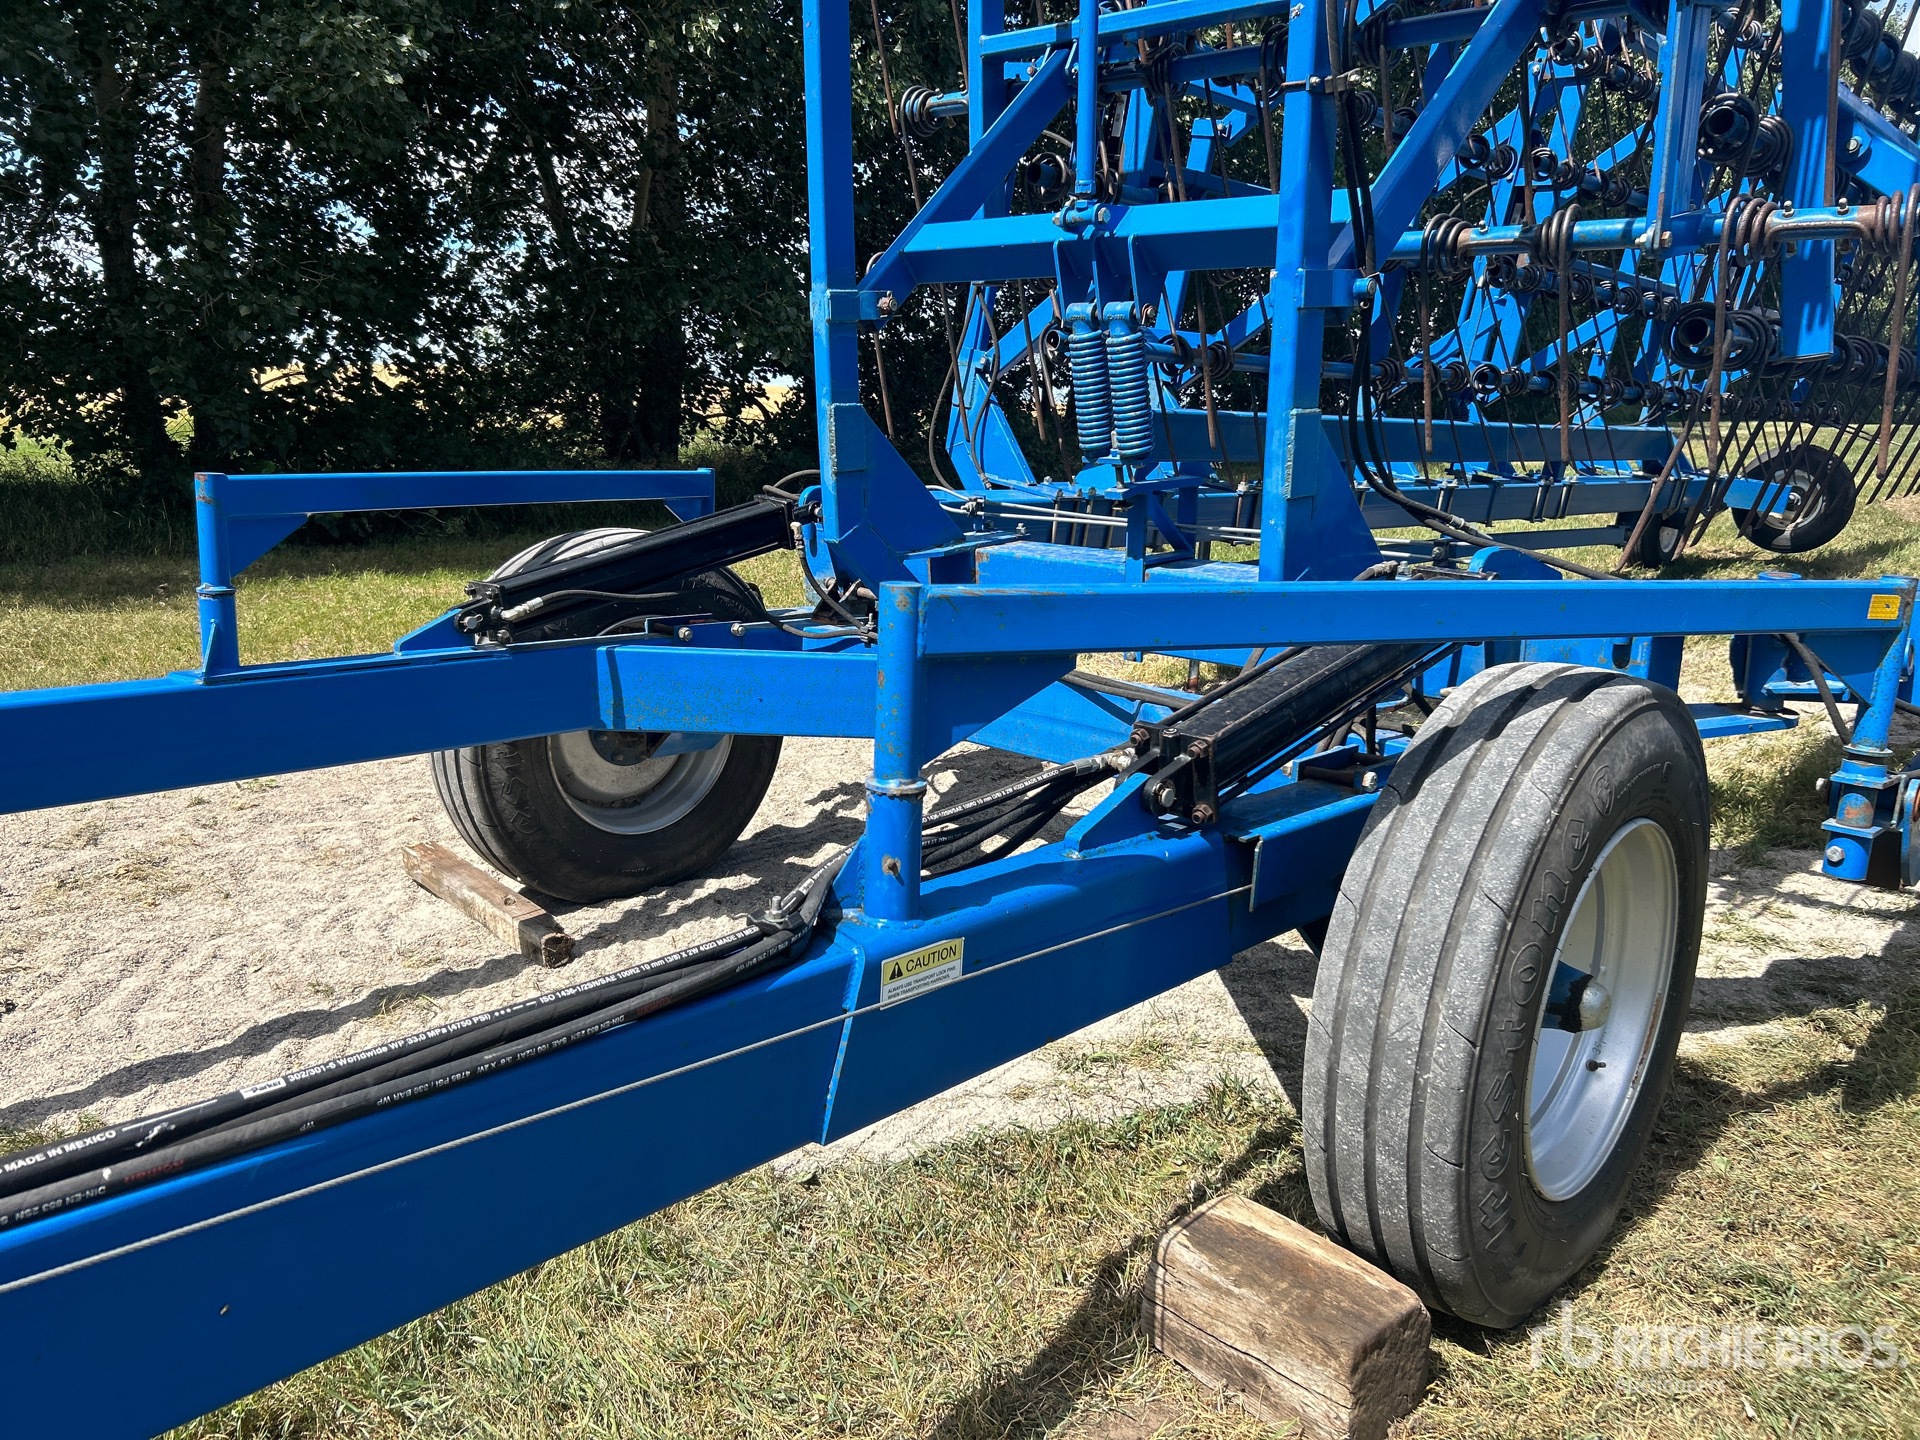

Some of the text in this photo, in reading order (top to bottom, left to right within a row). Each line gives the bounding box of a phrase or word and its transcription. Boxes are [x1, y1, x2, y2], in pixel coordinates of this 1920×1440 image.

[1024, 778, 1037, 787] MADE
[1042, 769, 1059, 779] MEXICO
[905, 944, 957, 972] CAUTION
[887, 965, 956, 994] ALWAYS USE TRANSPORT LOCK PINS
[887, 991, 900, 1000] WHEN
[900, 981, 930, 997] TRANSPORTING
[338, 1046, 388, 1066] Worldwide
[388, 1041, 404, 1050] WP
[427, 1027, 447, 1038] MPa
[473, 1013, 491, 1025] PSI)
[540, 994, 555, 1004] ISO
[617, 966, 640, 979] 100R2
[640, 963, 650, 971] 10
[651, 958, 665, 968] mm
[687, 947, 699, 956] 2W
[716, 934, 737, 947] MADE
[377, 1095, 391, 1106] WP
[393, 1088, 412, 1100] BAR
[3, 1129, 117, 1173] MADE IN MEXICO
